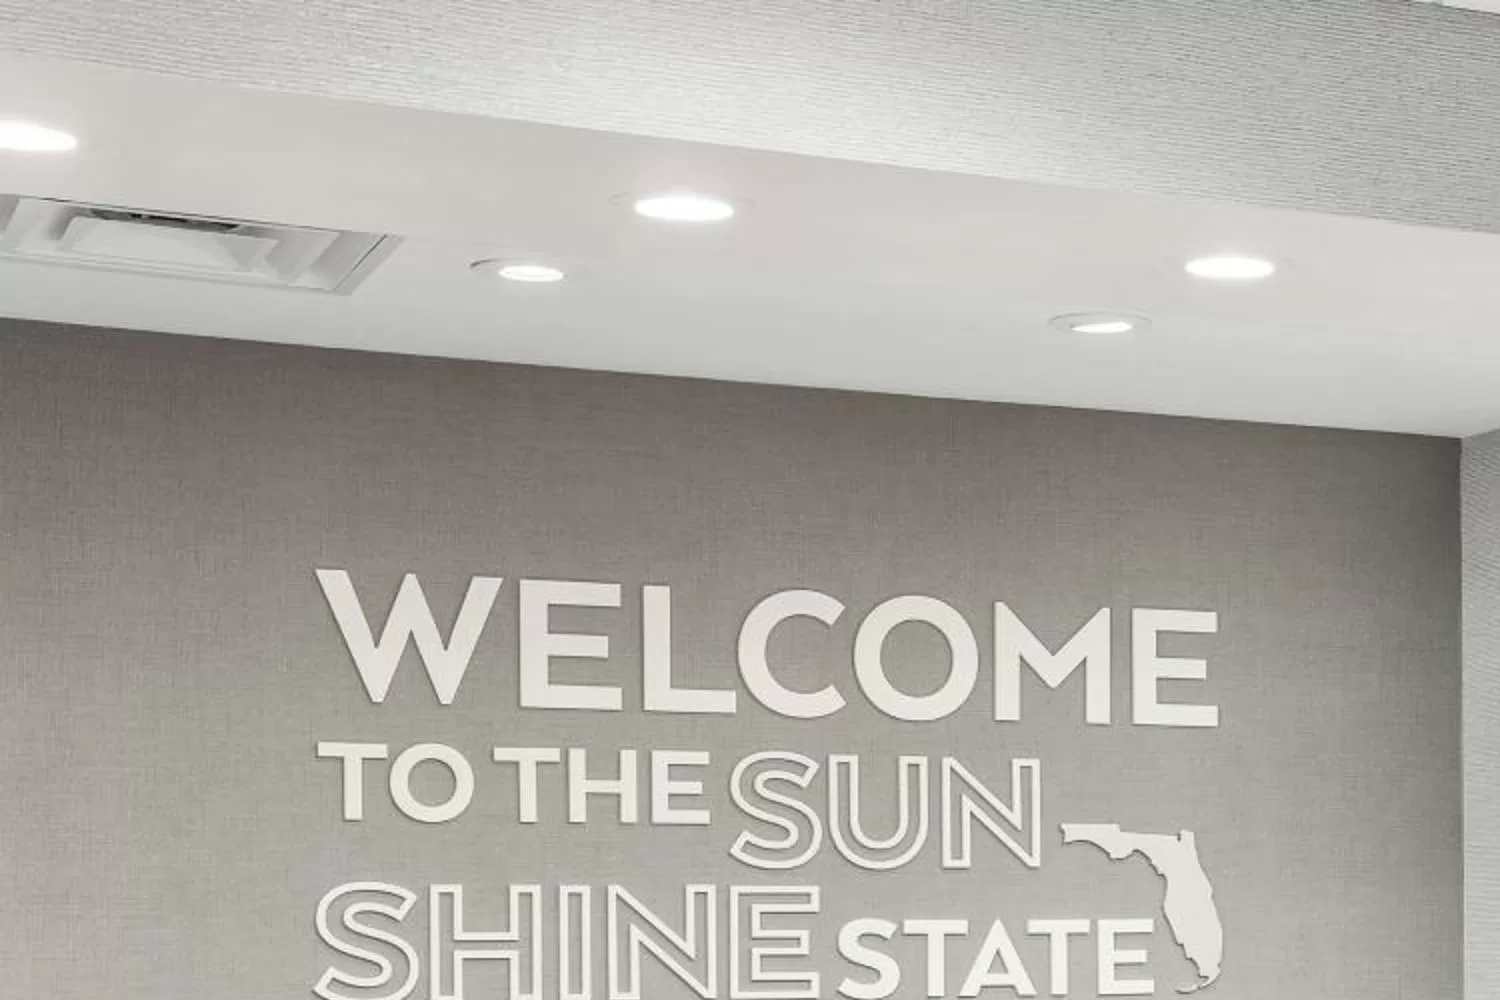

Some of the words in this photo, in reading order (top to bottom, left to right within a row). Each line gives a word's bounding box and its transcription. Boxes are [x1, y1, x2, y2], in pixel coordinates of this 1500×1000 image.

[315, 568, 1219, 727] WELCOME
[316, 741, 474, 824] TO
[493, 746, 712, 826] THE
[729, 750, 1042, 871] SUN
[837, 916, 1155, 1000] STATE
